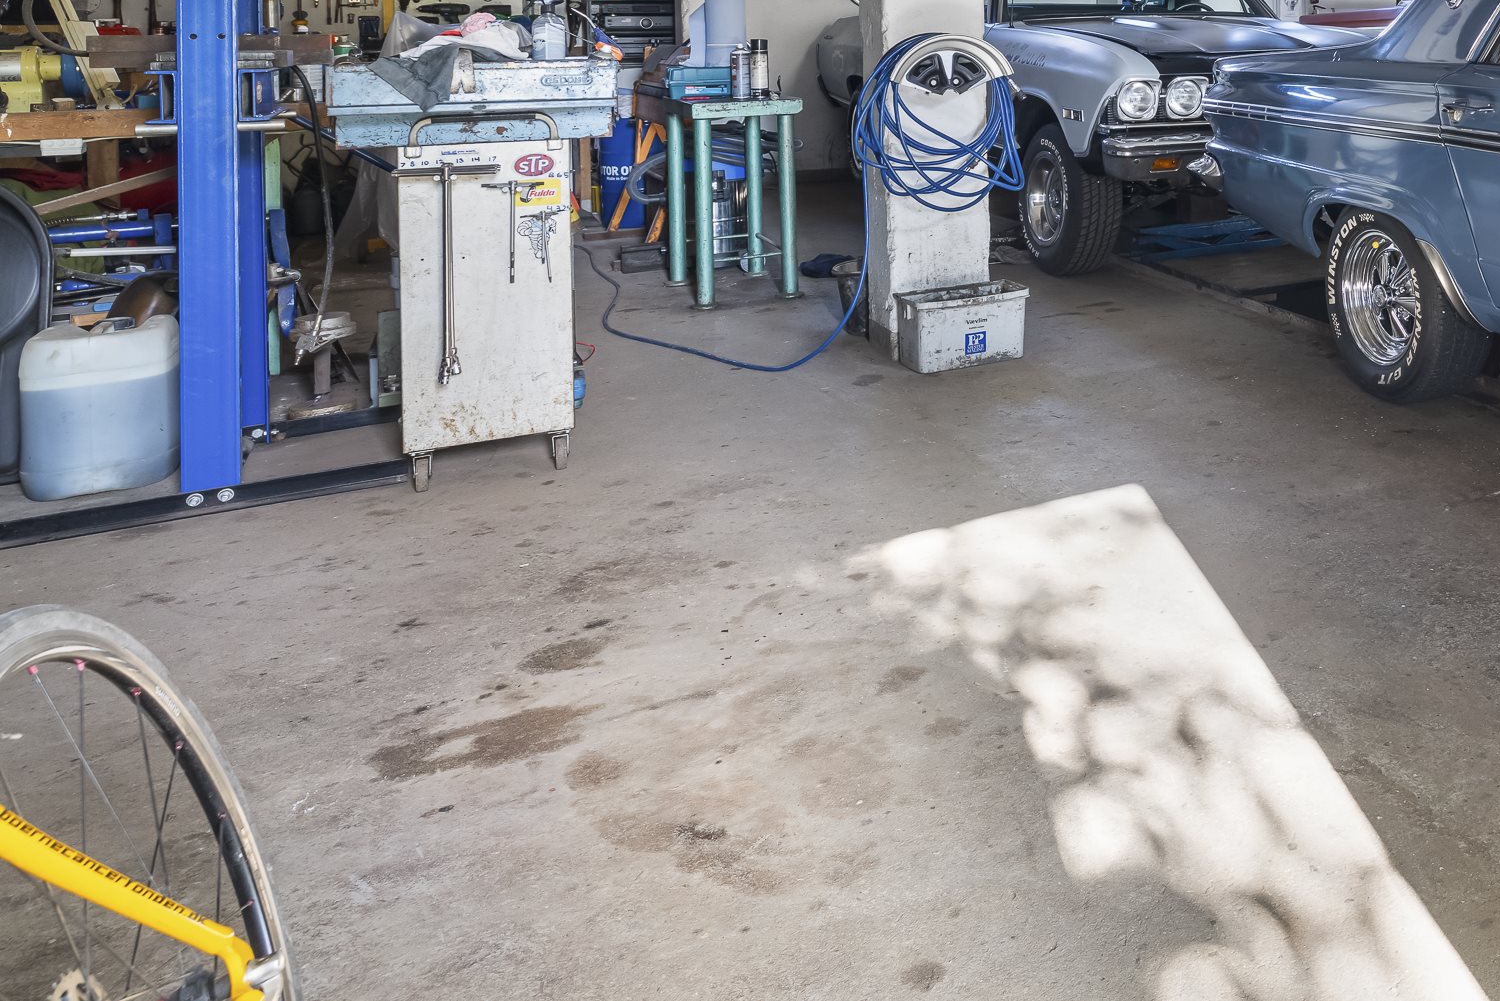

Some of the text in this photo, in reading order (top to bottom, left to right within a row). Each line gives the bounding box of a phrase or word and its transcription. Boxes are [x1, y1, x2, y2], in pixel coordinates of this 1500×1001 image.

[1040, 138, 1062, 162] COOPER
[518, 157, 550, 173] STP
[601, 165, 619, 175] TOR
[529, 189, 555, 198] Fulda
[1328, 215, 1357, 305] WINSTON
[1377, 367, 1402, 385] G/T
